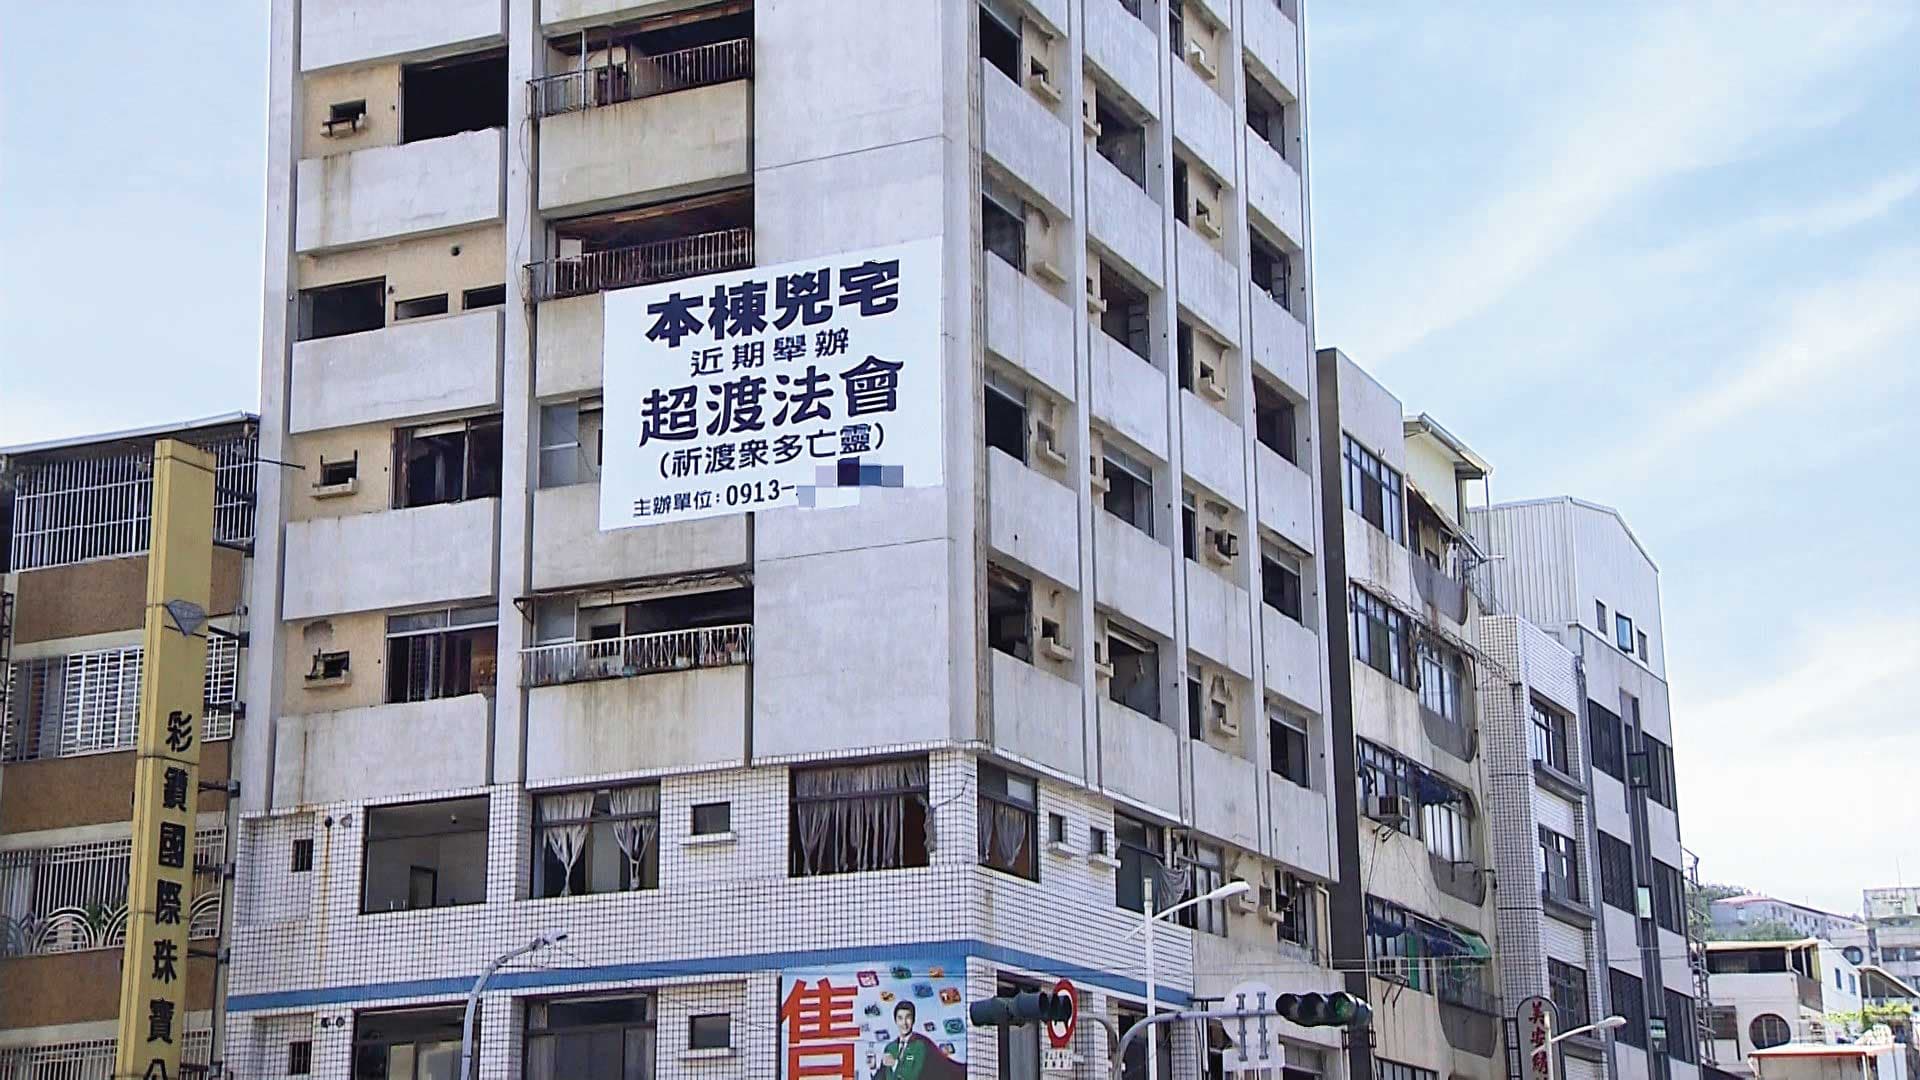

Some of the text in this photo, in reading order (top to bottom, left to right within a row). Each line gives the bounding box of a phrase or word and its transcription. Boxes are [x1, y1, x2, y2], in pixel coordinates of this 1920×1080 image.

[645, 259, 901, 348] 本棟兇宅
[690, 328, 850, 377] 近期舉辦
[639, 355, 904, 448] 超渡法會
[781, 977, 861, 1080] 售
